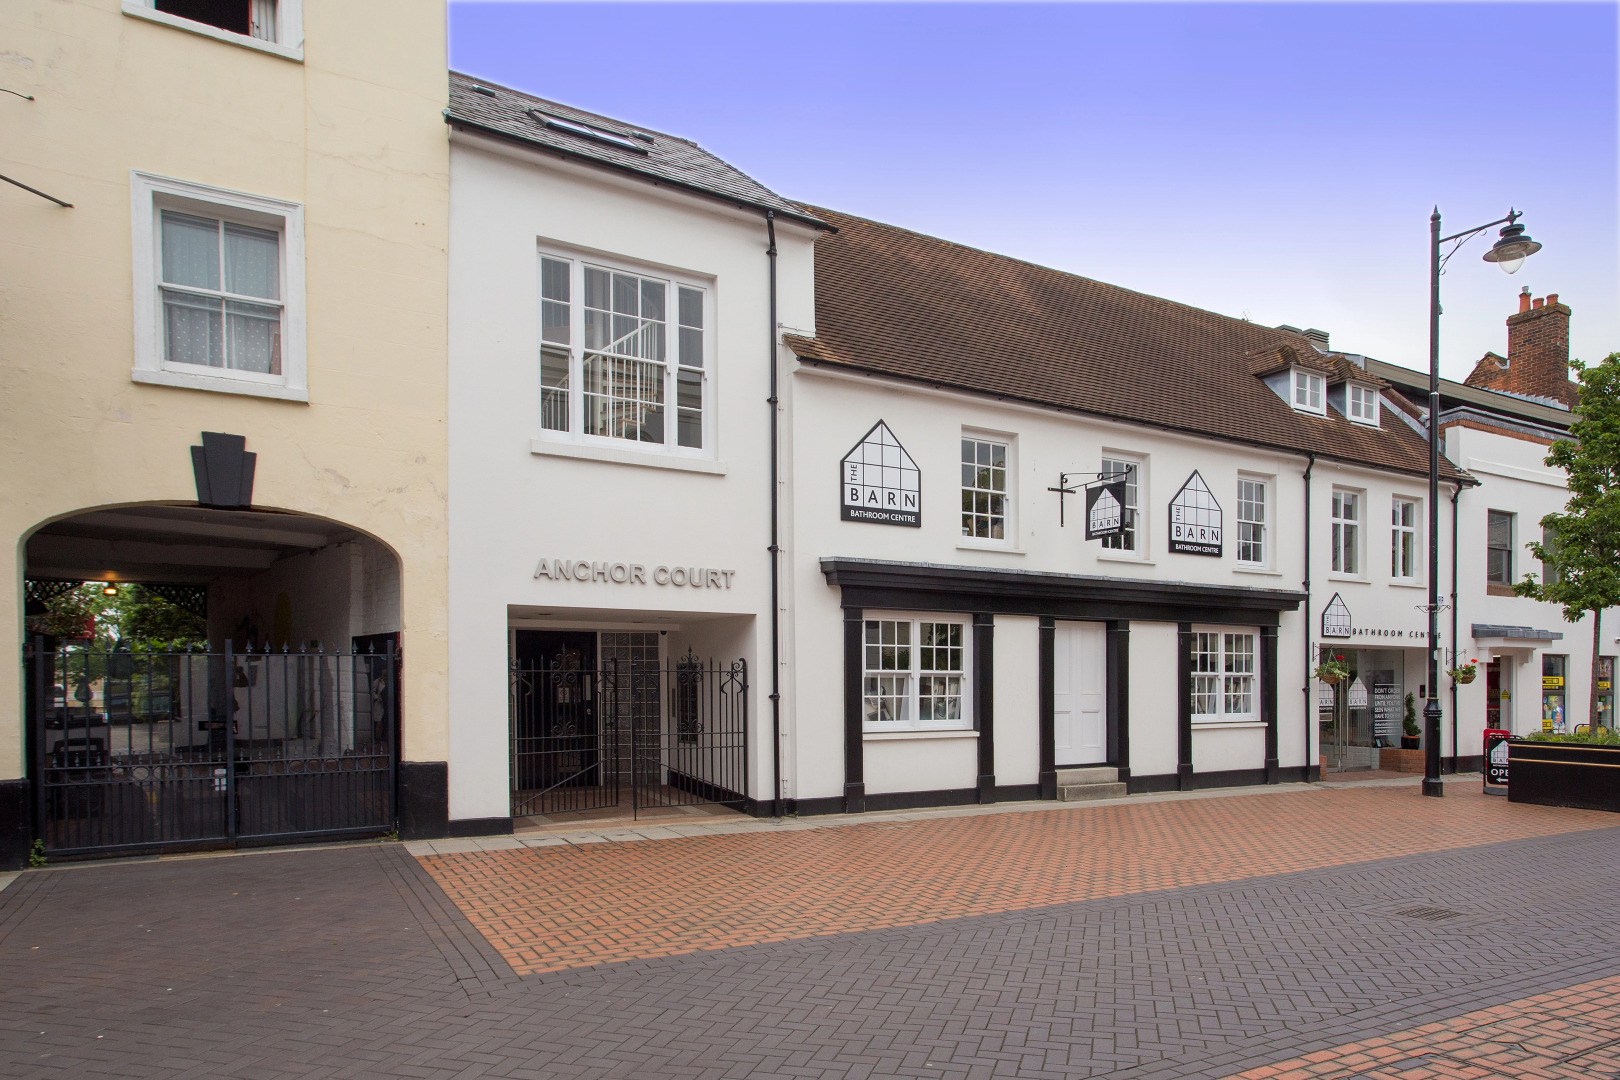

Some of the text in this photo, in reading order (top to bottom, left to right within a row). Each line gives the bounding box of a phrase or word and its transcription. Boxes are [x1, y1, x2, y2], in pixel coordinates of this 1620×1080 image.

[850, 464, 858, 482] THE
[850, 487, 916, 508] BARN
[850, 509, 916, 523] BATHROOM CENTRE
[1092, 518, 1119, 529] BARN
[1175, 526, 1219, 542] BARN
[1175, 543, 1219, 554] BATHROOM CENTRE
[534, 558, 735, 589] ANCHOR COURT
[1325, 626, 1350, 634] BARN
[1352, 627, 1442, 639] BATHROOM CENTE
[1491, 768, 1509, 776] OPE
